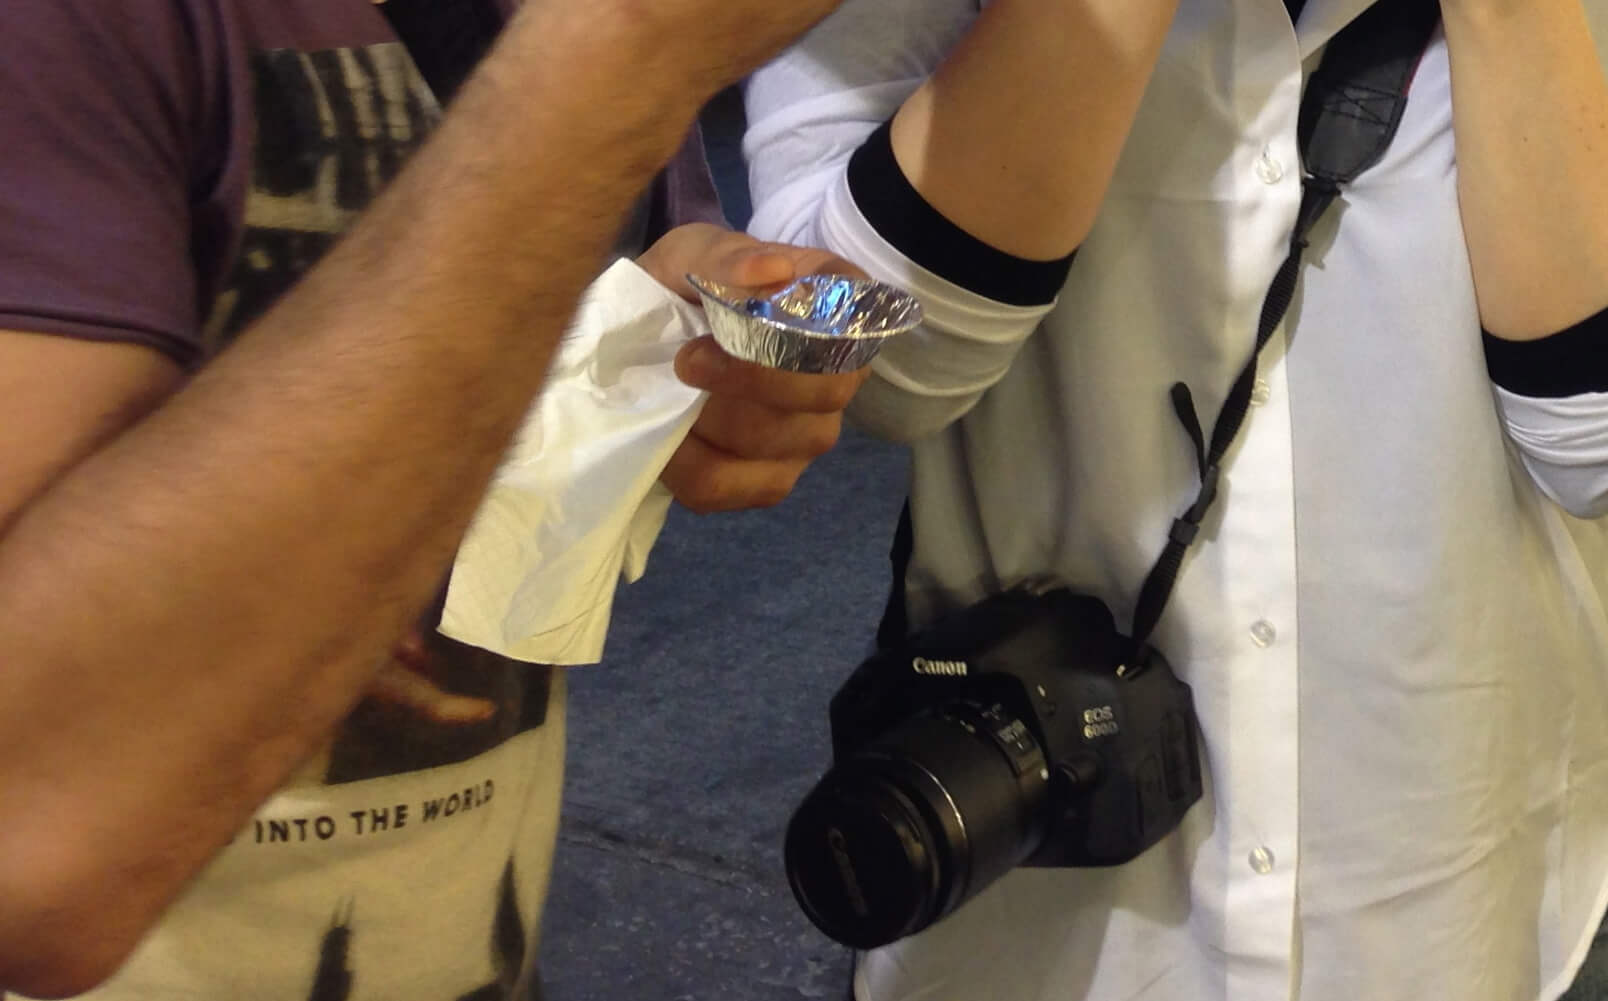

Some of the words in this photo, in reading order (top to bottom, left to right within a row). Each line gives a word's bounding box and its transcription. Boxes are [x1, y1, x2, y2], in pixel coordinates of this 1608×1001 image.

[912, 656, 968, 677] Canon
[255, 815, 336, 844] INTO
[349, 804, 409, 835] THE
[421, 778, 496, 823] WORLD
